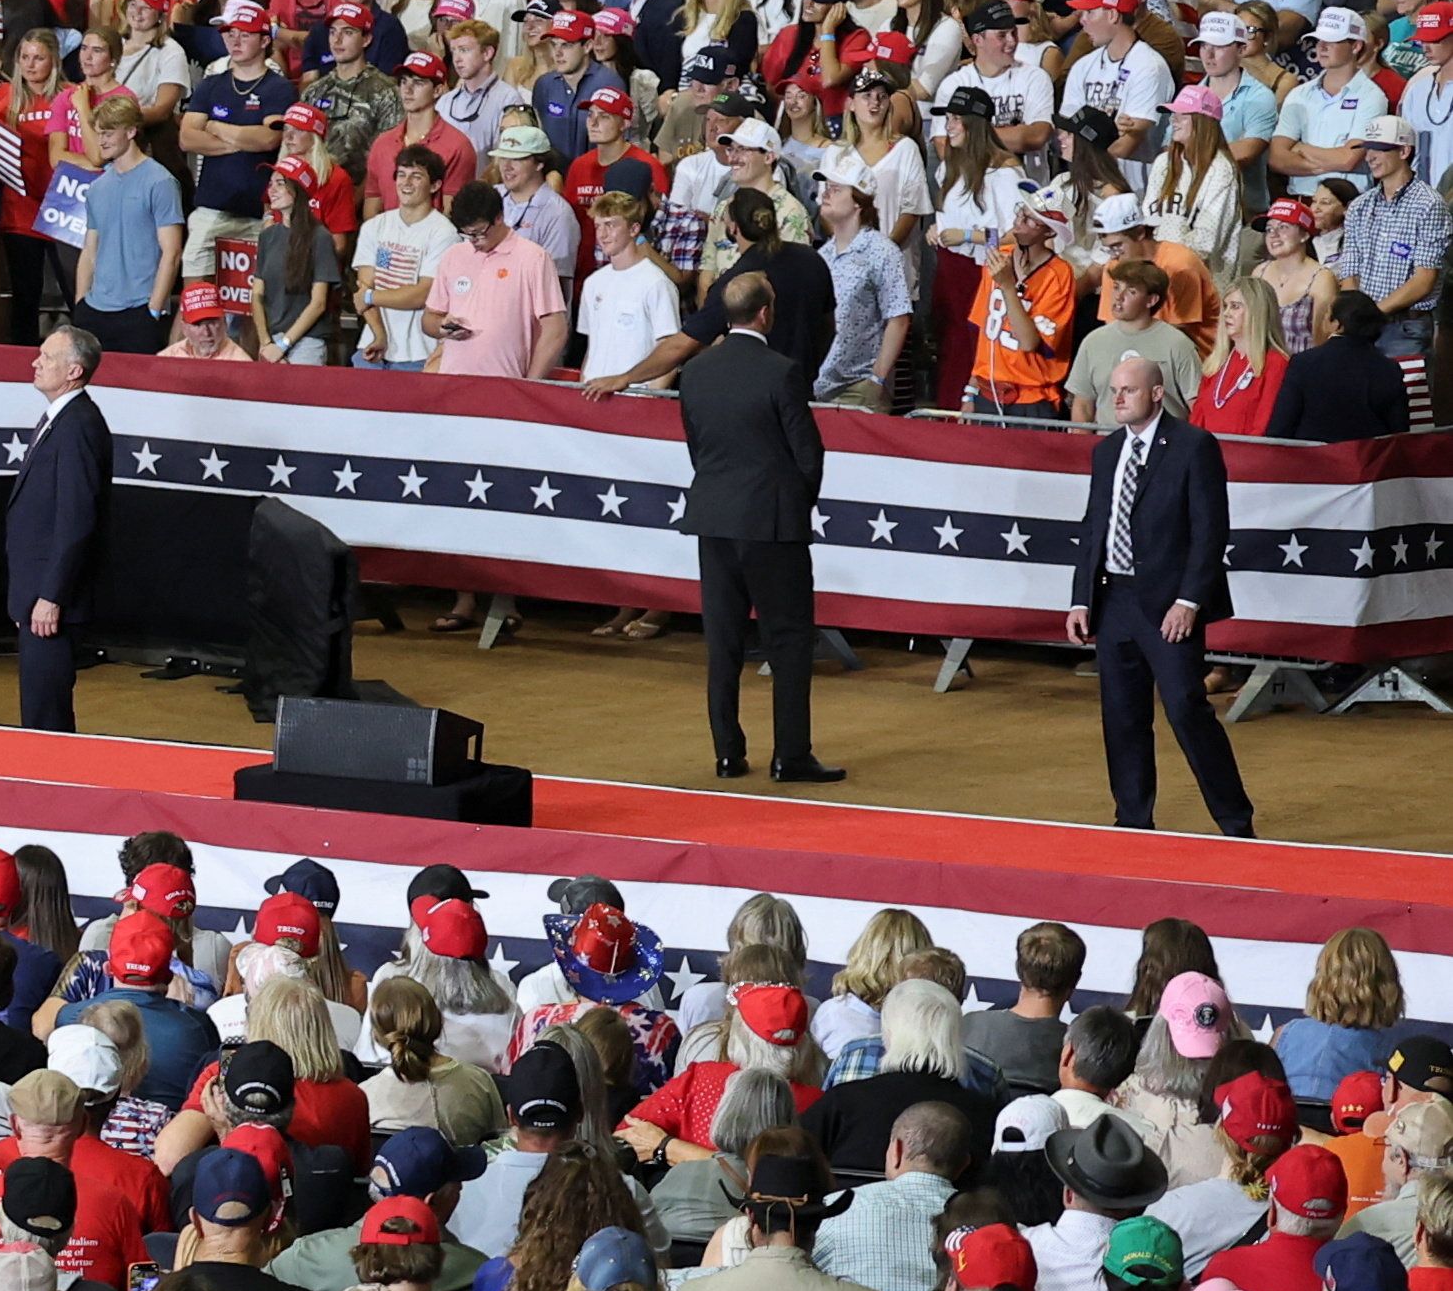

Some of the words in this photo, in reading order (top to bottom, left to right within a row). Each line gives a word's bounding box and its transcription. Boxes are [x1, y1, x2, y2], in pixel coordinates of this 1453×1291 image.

[221, 250, 250, 271] NO
[277, 926, 306, 935] TRUMP
[125, 962, 151, 972] TRUMP
[66, 1258, 94, 1267] virtue
[1122, 1251, 1151, 1264] DONALD
